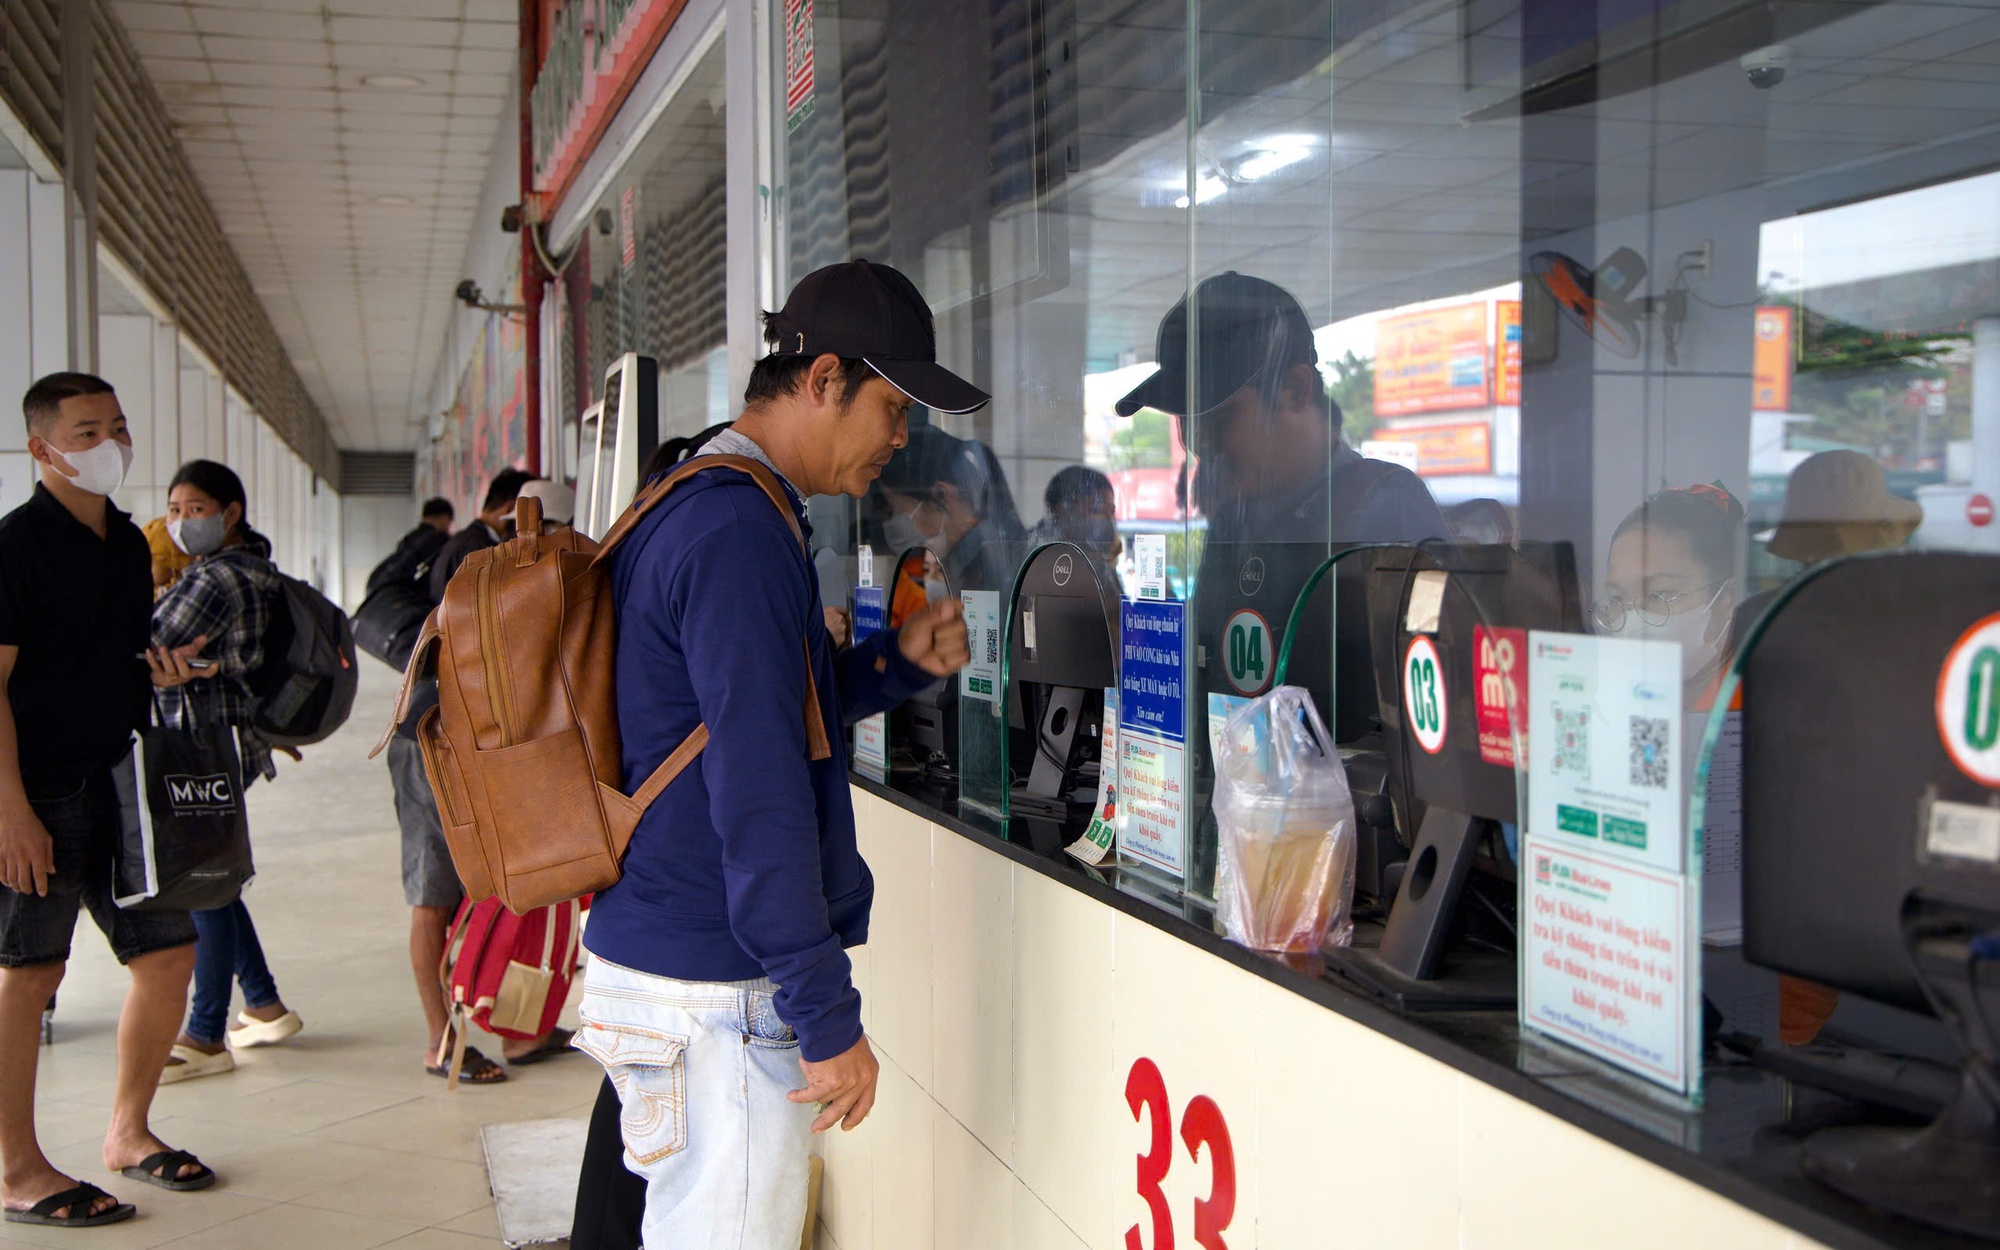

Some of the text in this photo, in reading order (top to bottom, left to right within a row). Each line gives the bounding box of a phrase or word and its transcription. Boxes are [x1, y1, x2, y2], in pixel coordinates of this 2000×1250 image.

[1056, 565, 1069, 574] DELL
[1242, 571, 1261, 582] DELL
[1134, 614, 1146, 630] Khách
[1133, 642, 1142, 661] VÀO
[1170, 650, 1179, 666] Nhà
[1230, 624, 1264, 680] 04
[1140, 677, 1146, 692] XE
[1147, 674, 1157, 694] MÁY
[1158, 680, 1167, 700] hoặc
[1168, 677, 1172, 697] Ô
[1411, 657, 1438, 733] 03
[1136, 705, 1164, 722] Xin cảm ơn!
[171, 780, 229, 802] MWC
[1124, 766, 1132, 781] Quý
[1134, 769, 1148, 783] Khách
[1168, 777, 1179, 793] kiểm
[1137, 788, 1149, 802] thông
[1158, 794, 1167, 807] trên
[1174, 800, 1179, 812] và
[1136, 806, 1146, 818] thừa
[1147, 810, 1159, 823] trước
[1139, 823, 1162, 844] khỏi quầy.
[1535, 895, 1672, 953] Quý Khách vui lòng kiểm
[1534, 924, 1548, 940] tra
[1566, 933, 1596, 960] thông
[1599, 942, 1614, 962] tin
[1617, 950, 1639, 971] trên
[1659, 964, 1673, 984] và
[1590, 969, 1619, 992] trước
[1623, 978, 1642, 1000] khi
